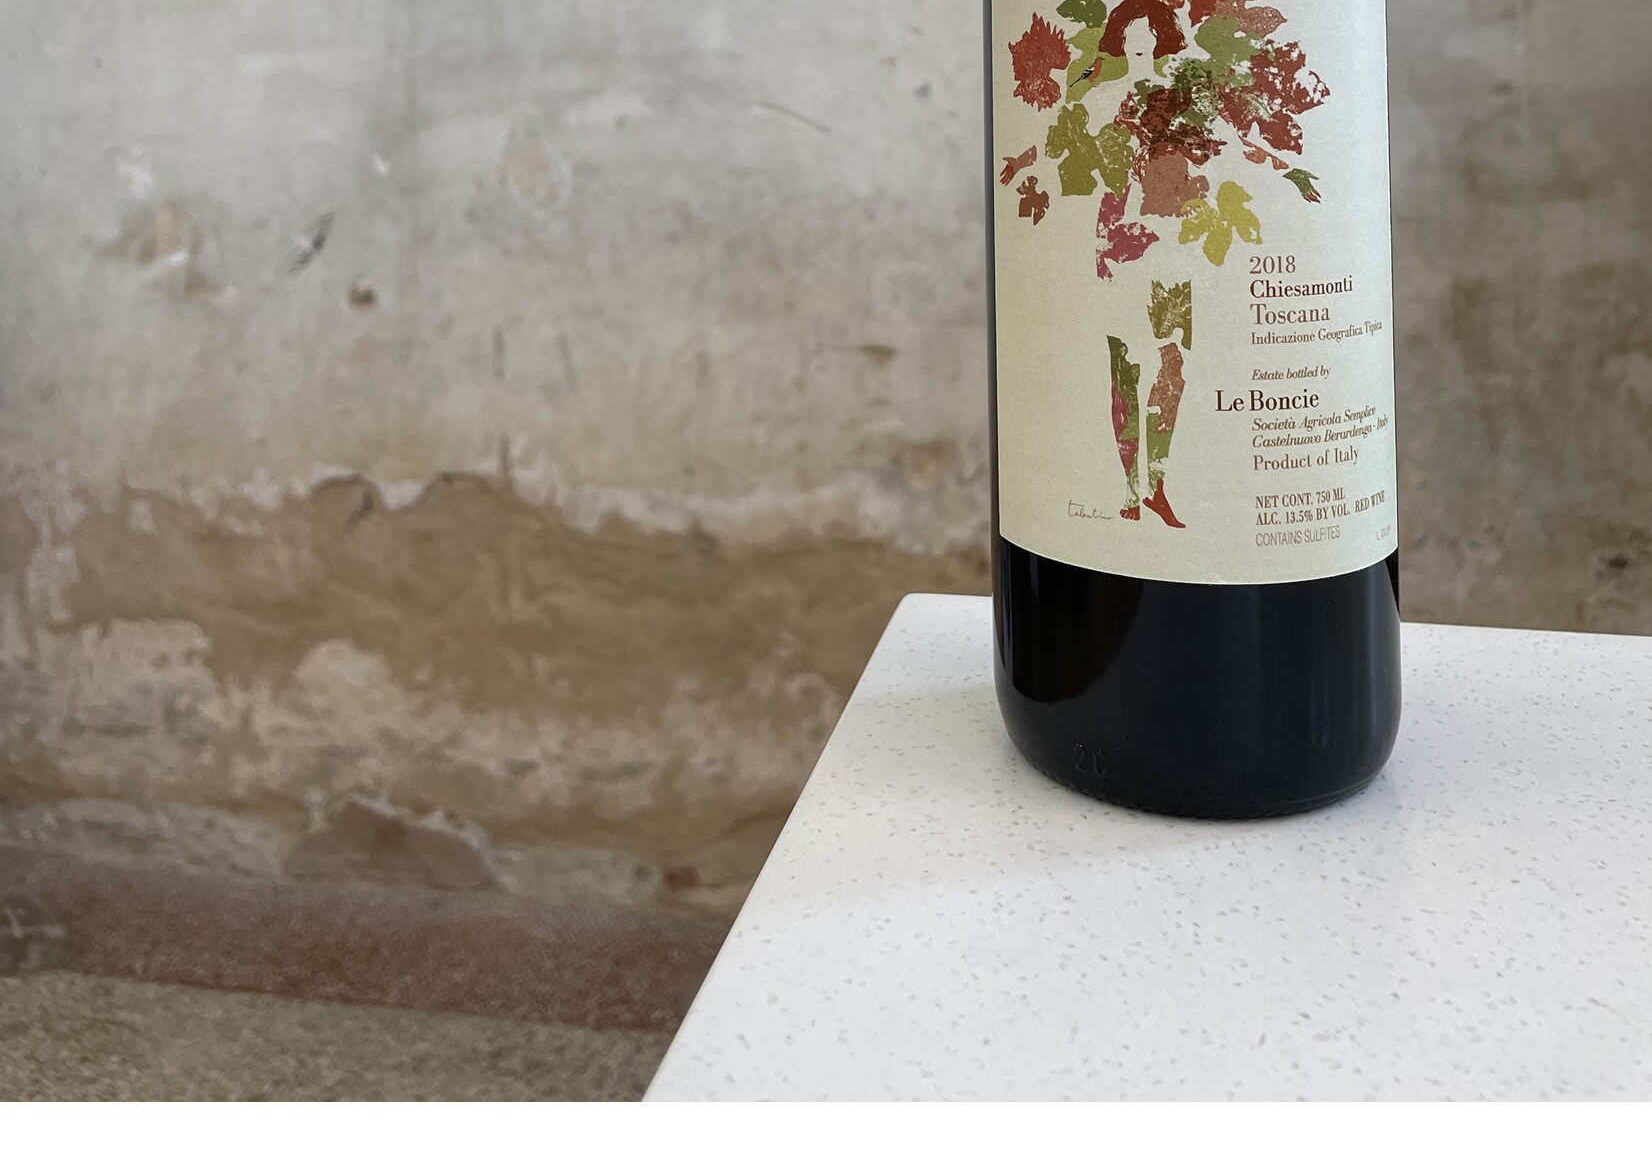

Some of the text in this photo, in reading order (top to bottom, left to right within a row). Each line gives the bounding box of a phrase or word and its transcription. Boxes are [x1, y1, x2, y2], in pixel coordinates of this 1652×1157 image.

[1249, 256, 1296, 274] 2018
[1250, 275, 1353, 298] Chiesamonti
[1250, 304, 1330, 324] Toscana
[1251, 320, 1382, 345] Indicazione Geografica Tipica
[1252, 366, 1331, 381] Estate bottled by
[1215, 388, 1319, 412] Le Boncie
[1252, 405, 1376, 432] Società Agricola Semplice
[1252, 434, 1321, 448] Castelnuovo
[1253, 445, 1359, 470] Product of Italy
[1255, 488, 1345, 508] NET CONT. 750 ML
[1256, 490, 1385, 526] ALC. 13.5% BY VOL. RED WINE
[1256, 525, 1340, 546] CONTAINS SULFITES
